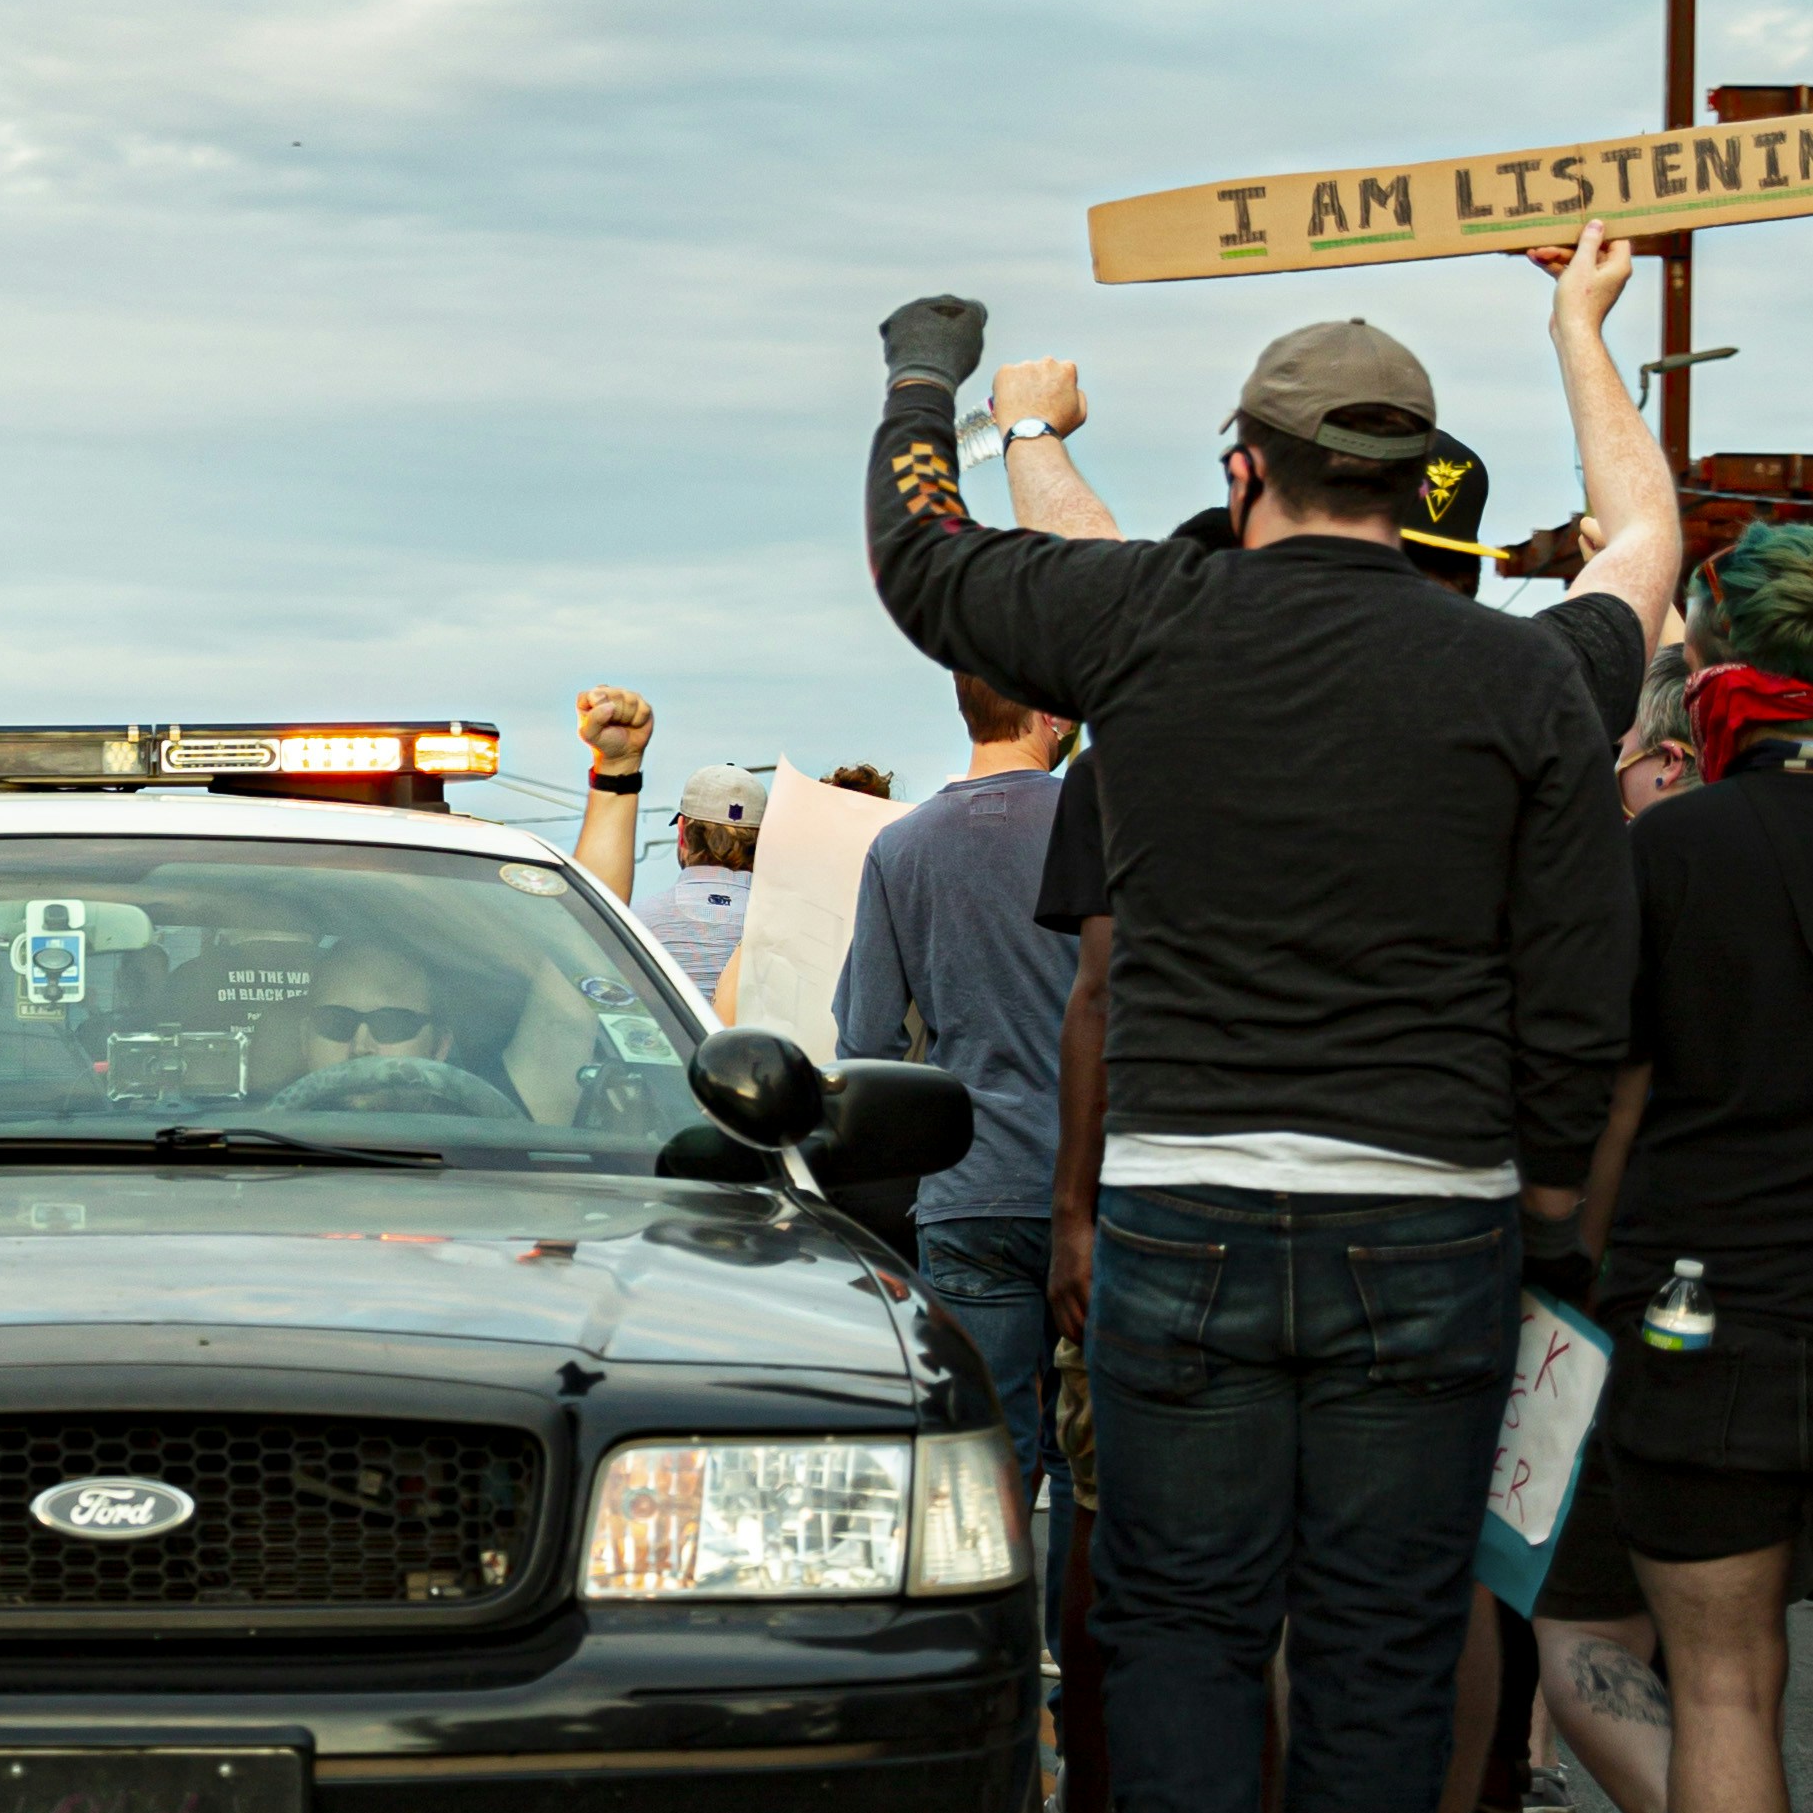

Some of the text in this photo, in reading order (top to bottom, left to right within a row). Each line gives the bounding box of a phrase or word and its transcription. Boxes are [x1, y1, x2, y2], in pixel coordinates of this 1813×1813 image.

[1217, 186, 1267, 247] I
[1307, 173, 1413, 237] AM
[228, 970, 310, 984] END THE WA
[218, 989, 236, 1002] ON
[239, 989, 284, 1001] BLACK
[69, 1487, 156, 1525] Ford
